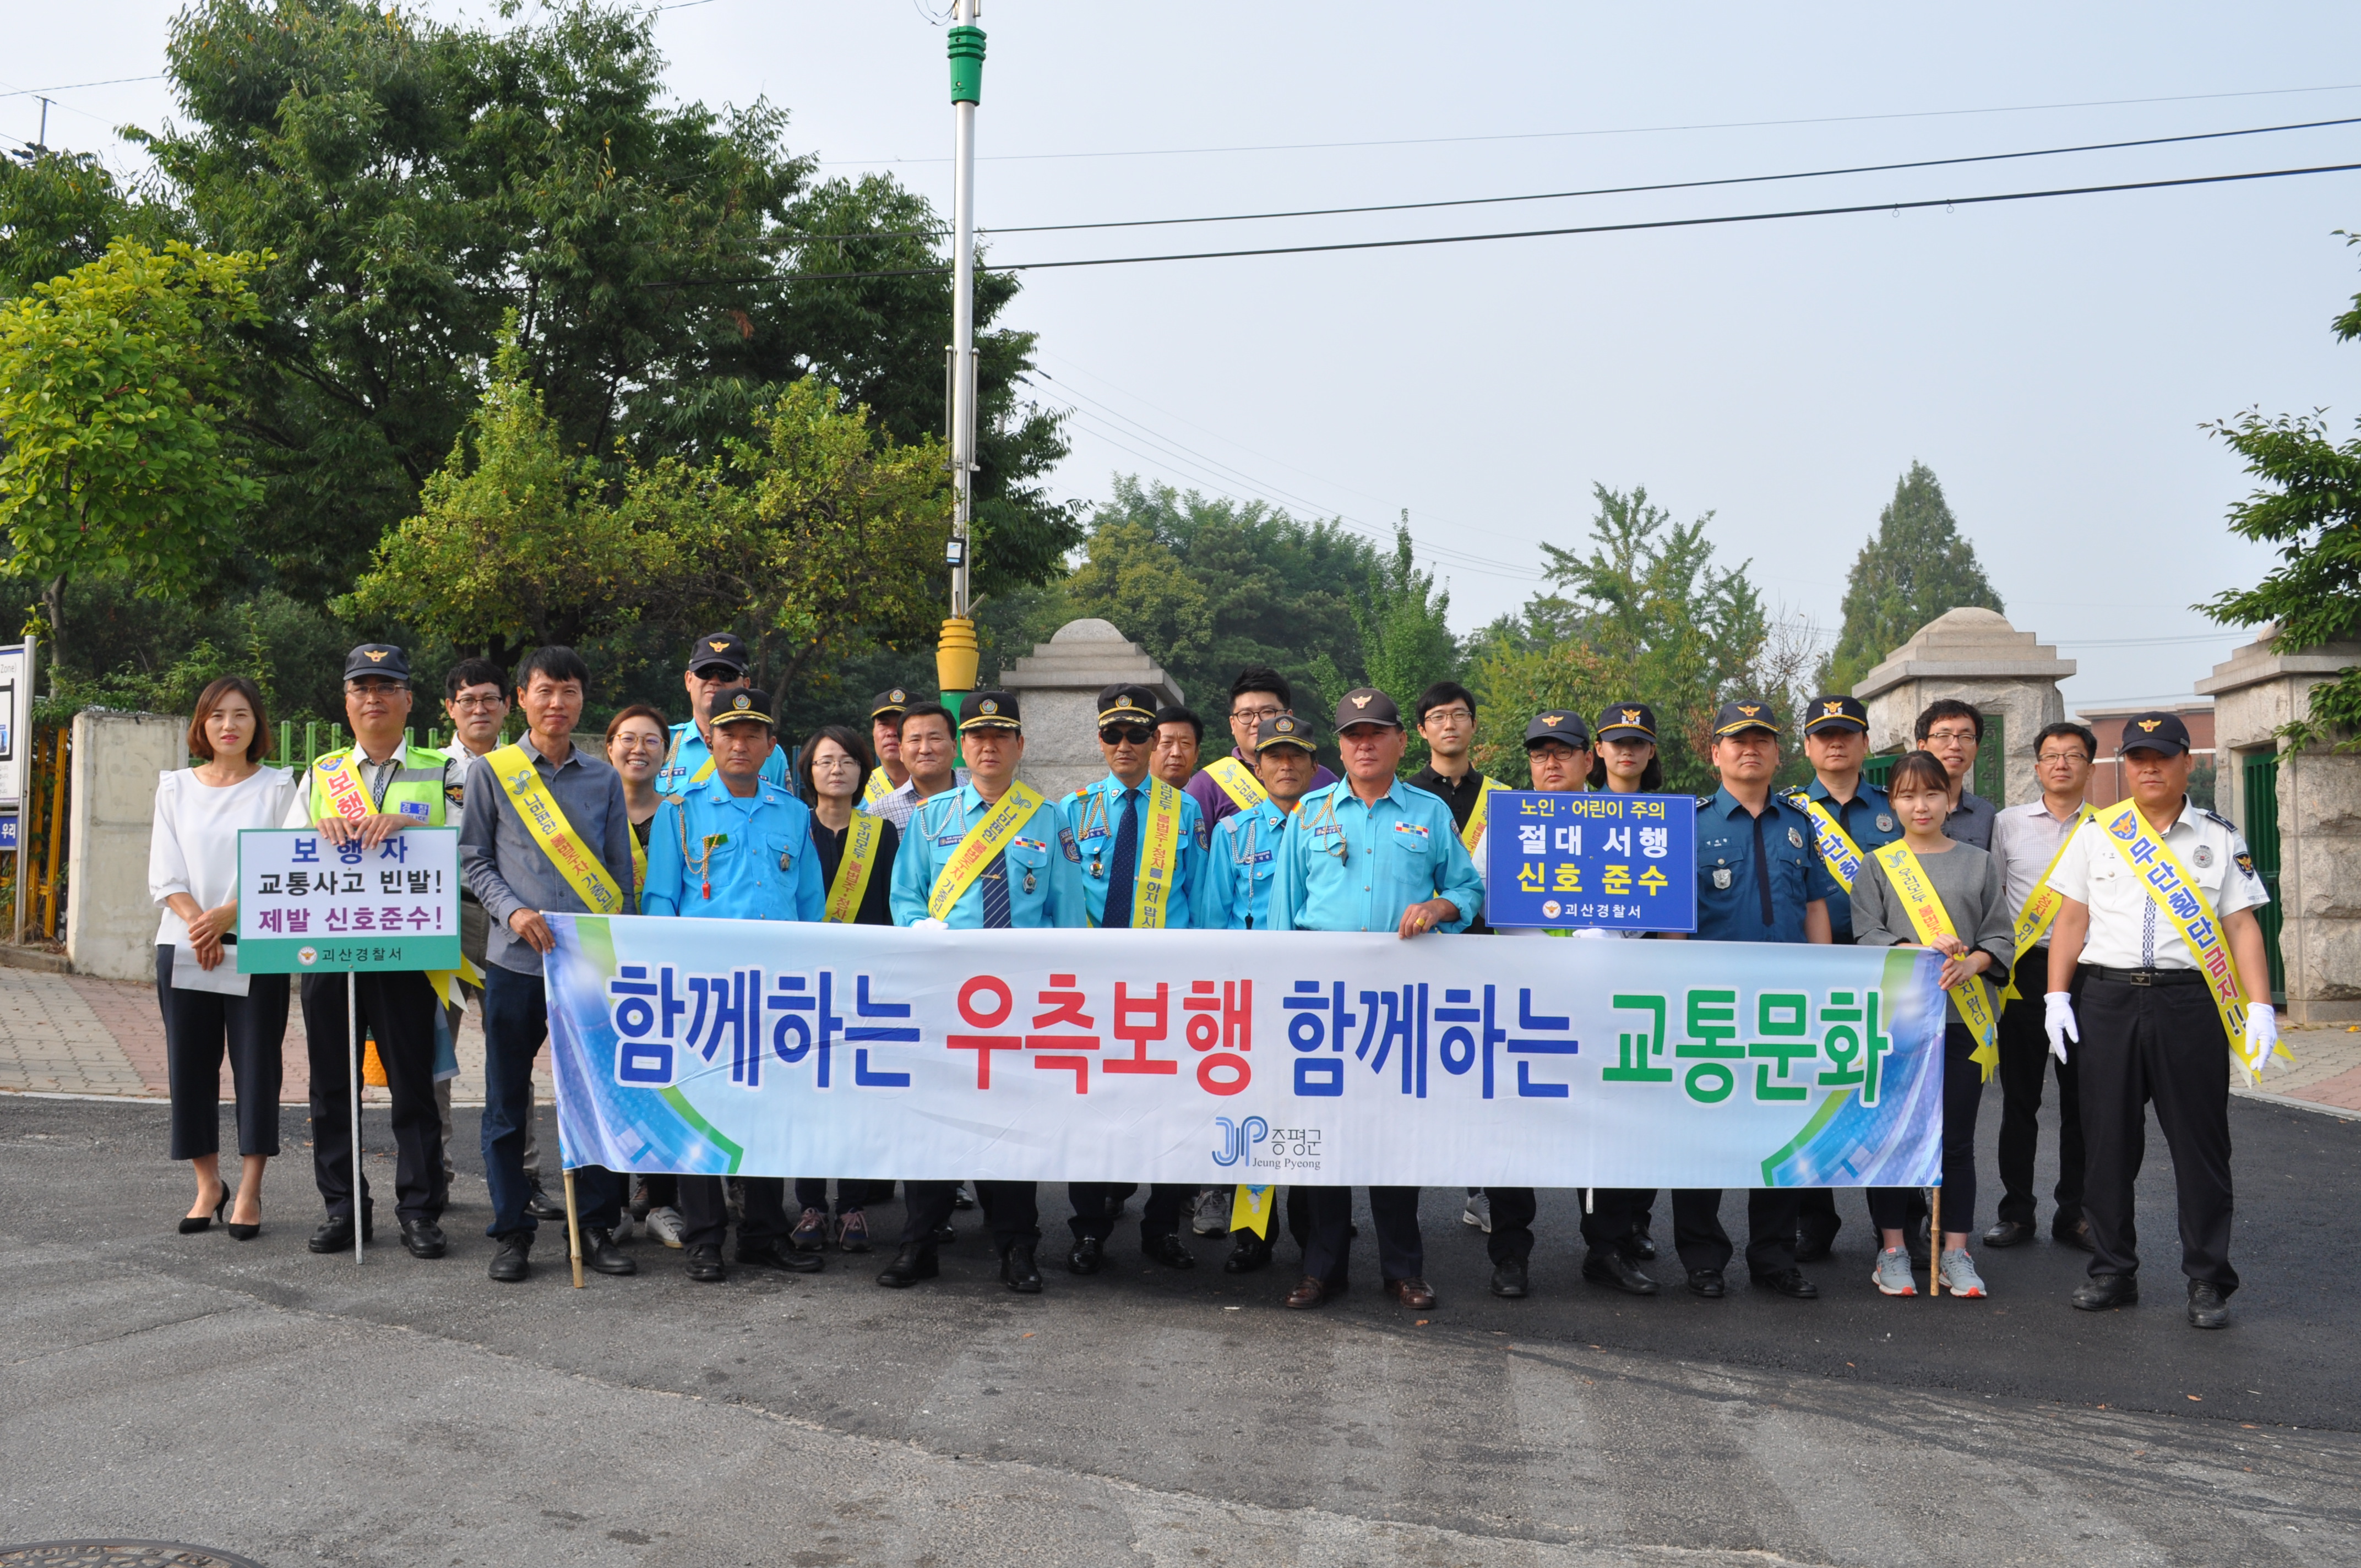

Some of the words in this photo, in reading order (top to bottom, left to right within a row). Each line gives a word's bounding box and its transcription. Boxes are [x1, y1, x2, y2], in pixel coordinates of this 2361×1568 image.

[1520, 799, 1554, 816] 노인
[1572, 799, 1623, 819] 어린이
[1630, 801, 1665, 820] 주의
[1517, 825, 1581, 856] 절대
[1602, 826, 1668, 858] 서행
[258, 871, 365, 896] 교통사고
[380, 870, 442, 894] 빈발!
[1516, 862, 1582, 892] 신호
[1602, 864, 1668, 896] 준수
[1144, 881, 1161, 905] 하지
[258, 908, 311, 933] 제발
[325, 906, 442, 931] 신호준수!
[1142, 906, 1157, 929] 맙시
[1565, 903, 1641, 919] 괴산경찰서
[322, 947, 401, 962] 괴산경찰서
[611, 966, 920, 1088] 함께하는
[946, 973, 1252, 1096] 우측보행
[1283, 981, 1579, 1099] 함께하는
[1602, 990, 1889, 1103] 교통문화
[1271, 1129, 1321, 1156] 증평군
[1252, 1158, 1281, 1170] Jeung
[1284, 1158, 1320, 1170] Pyeong
